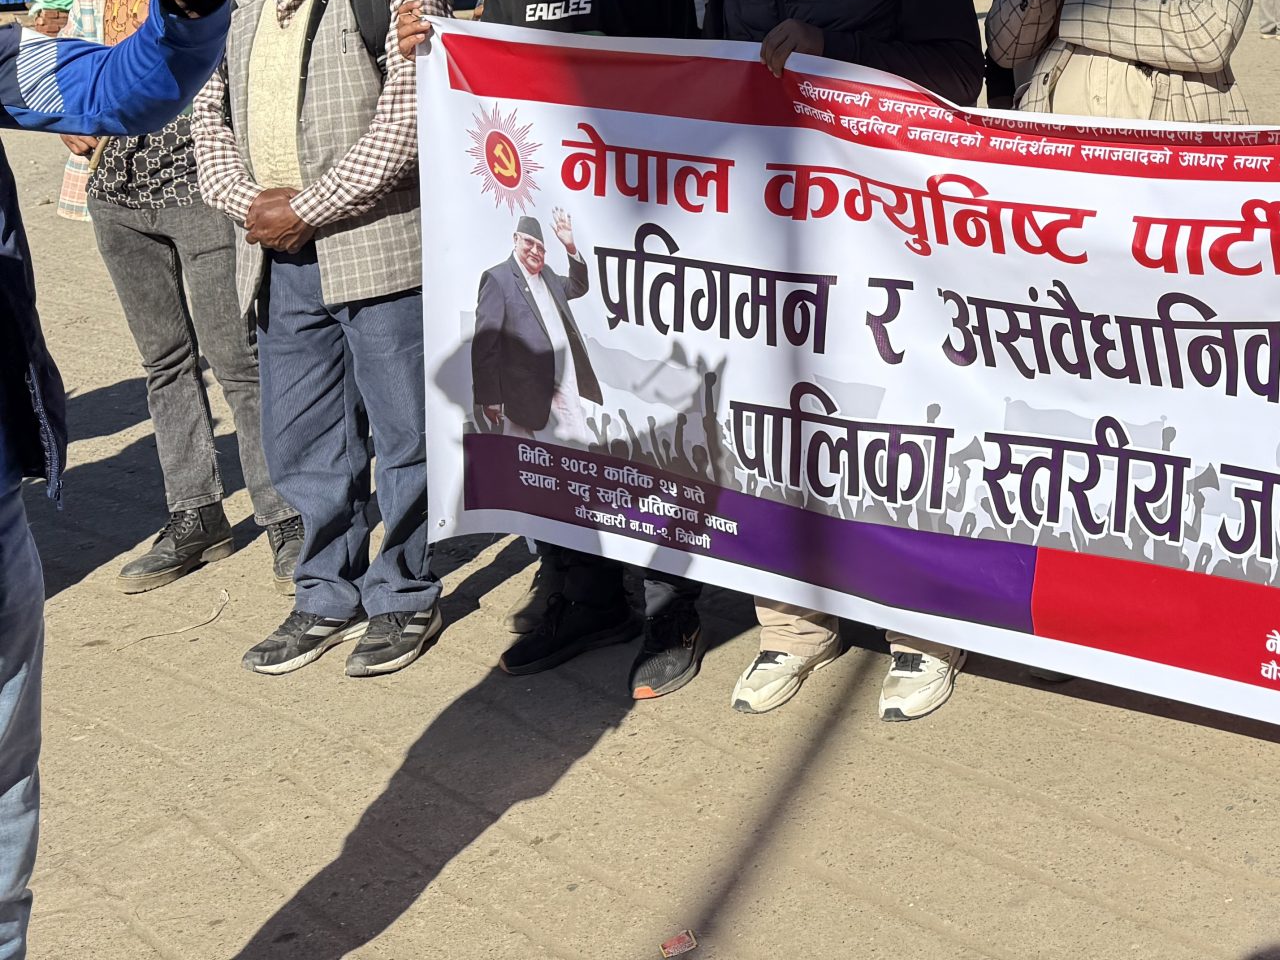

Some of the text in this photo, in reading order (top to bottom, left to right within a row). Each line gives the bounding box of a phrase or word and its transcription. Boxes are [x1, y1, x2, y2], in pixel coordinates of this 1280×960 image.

[797, 81, 873, 109] दक्षिणपन्थी
[793, 99, 836, 127] जनताको
[840, 114, 903, 137] बहुदलिय
[907, 124, 984, 149] जनवादको
[989, 133, 1076, 158] मार्गदर्शनमा
[1080, 143, 1173, 166] समाजवादको
[1178, 150, 1229, 171] आधार
[1233, 154, 1274, 172] तयार
[561, 123, 735, 214] नेपाल
[763, 162, 1097, 265] कम्युनिष्ट
[594, 222, 838, 354] प्रतिगमन
[865, 277, 914, 365] र
[561, 457, 598, 477] २०८२
[604, 465, 654, 490] कार्तिक
[683, 485, 706, 505] गते
[729, 381, 955, 511] पालिका
[983, 415, 1192, 543] स्तरीय
[596, 487, 633, 509] स्मृति
[638, 495, 699, 524] प्रतिष्ठान
[704, 512, 738, 536] भवन
